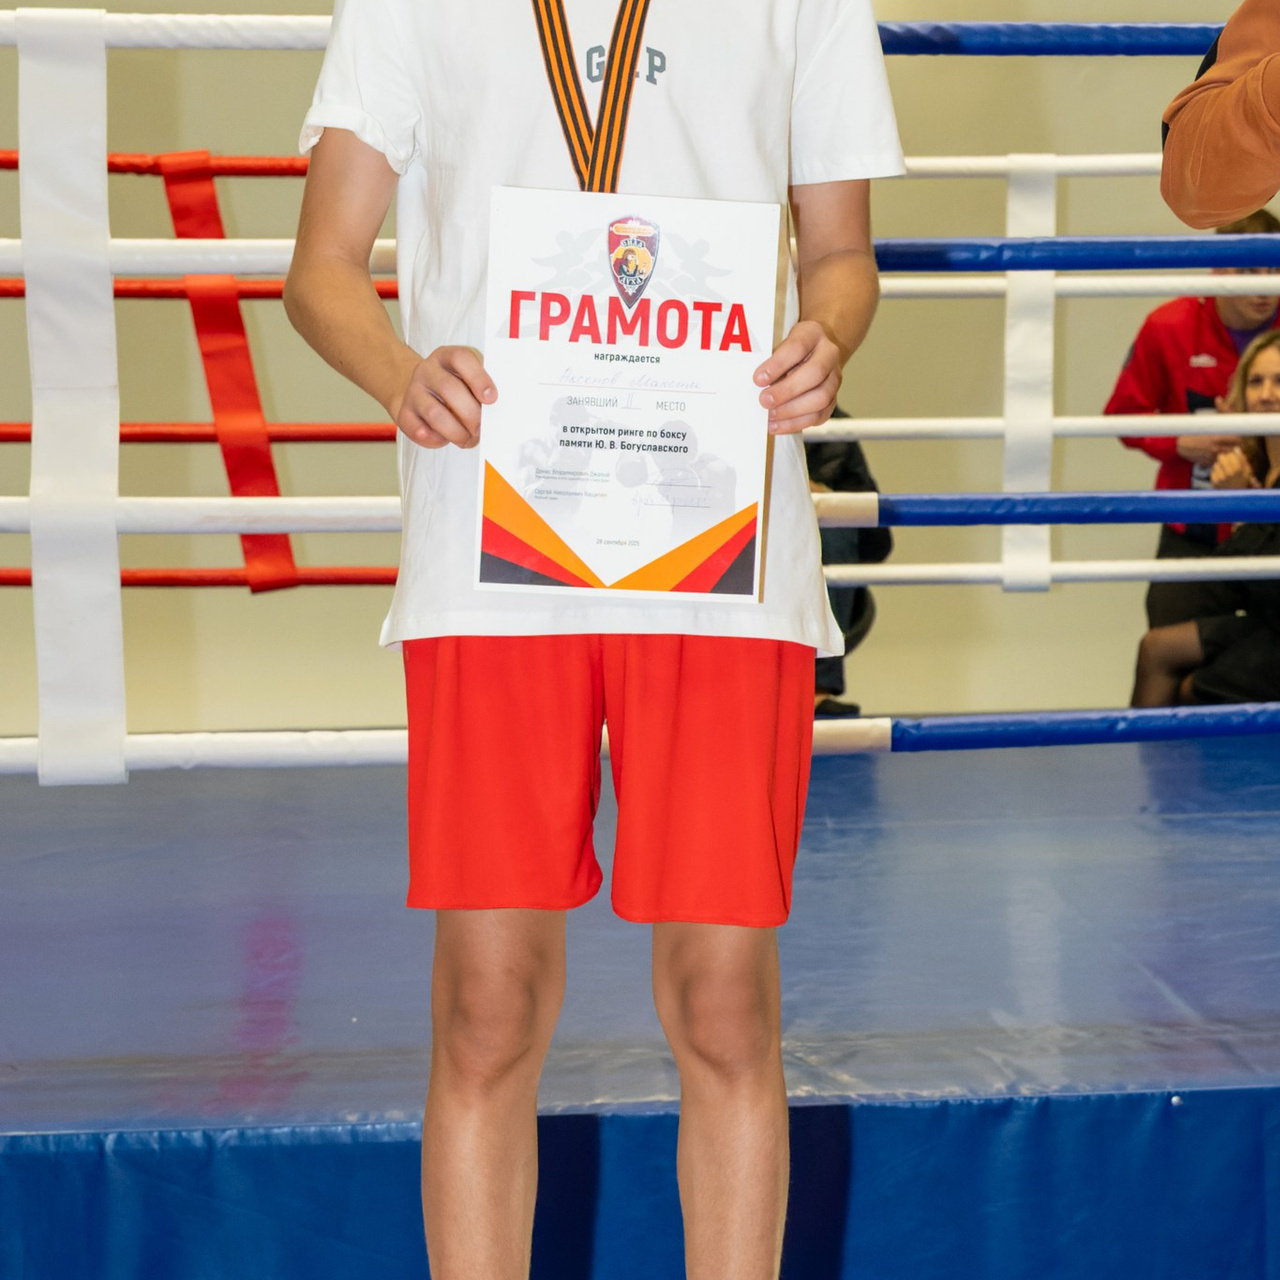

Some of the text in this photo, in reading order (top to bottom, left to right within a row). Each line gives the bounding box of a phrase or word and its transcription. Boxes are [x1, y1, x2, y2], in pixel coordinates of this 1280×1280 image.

[586, 44, 667, 86] GP
[508, 289, 753, 353] ГРАМОТА
[593, 351, 661, 365] награждается
[566, 396, 619, 408] ЗАНЯВШИЙ
[655, 401, 687, 412] МЕСТО
[562, 425, 687, 441] в открытом ринге по боксу
[559, 439, 689, 454] памяти Ю. В. Богуславского
